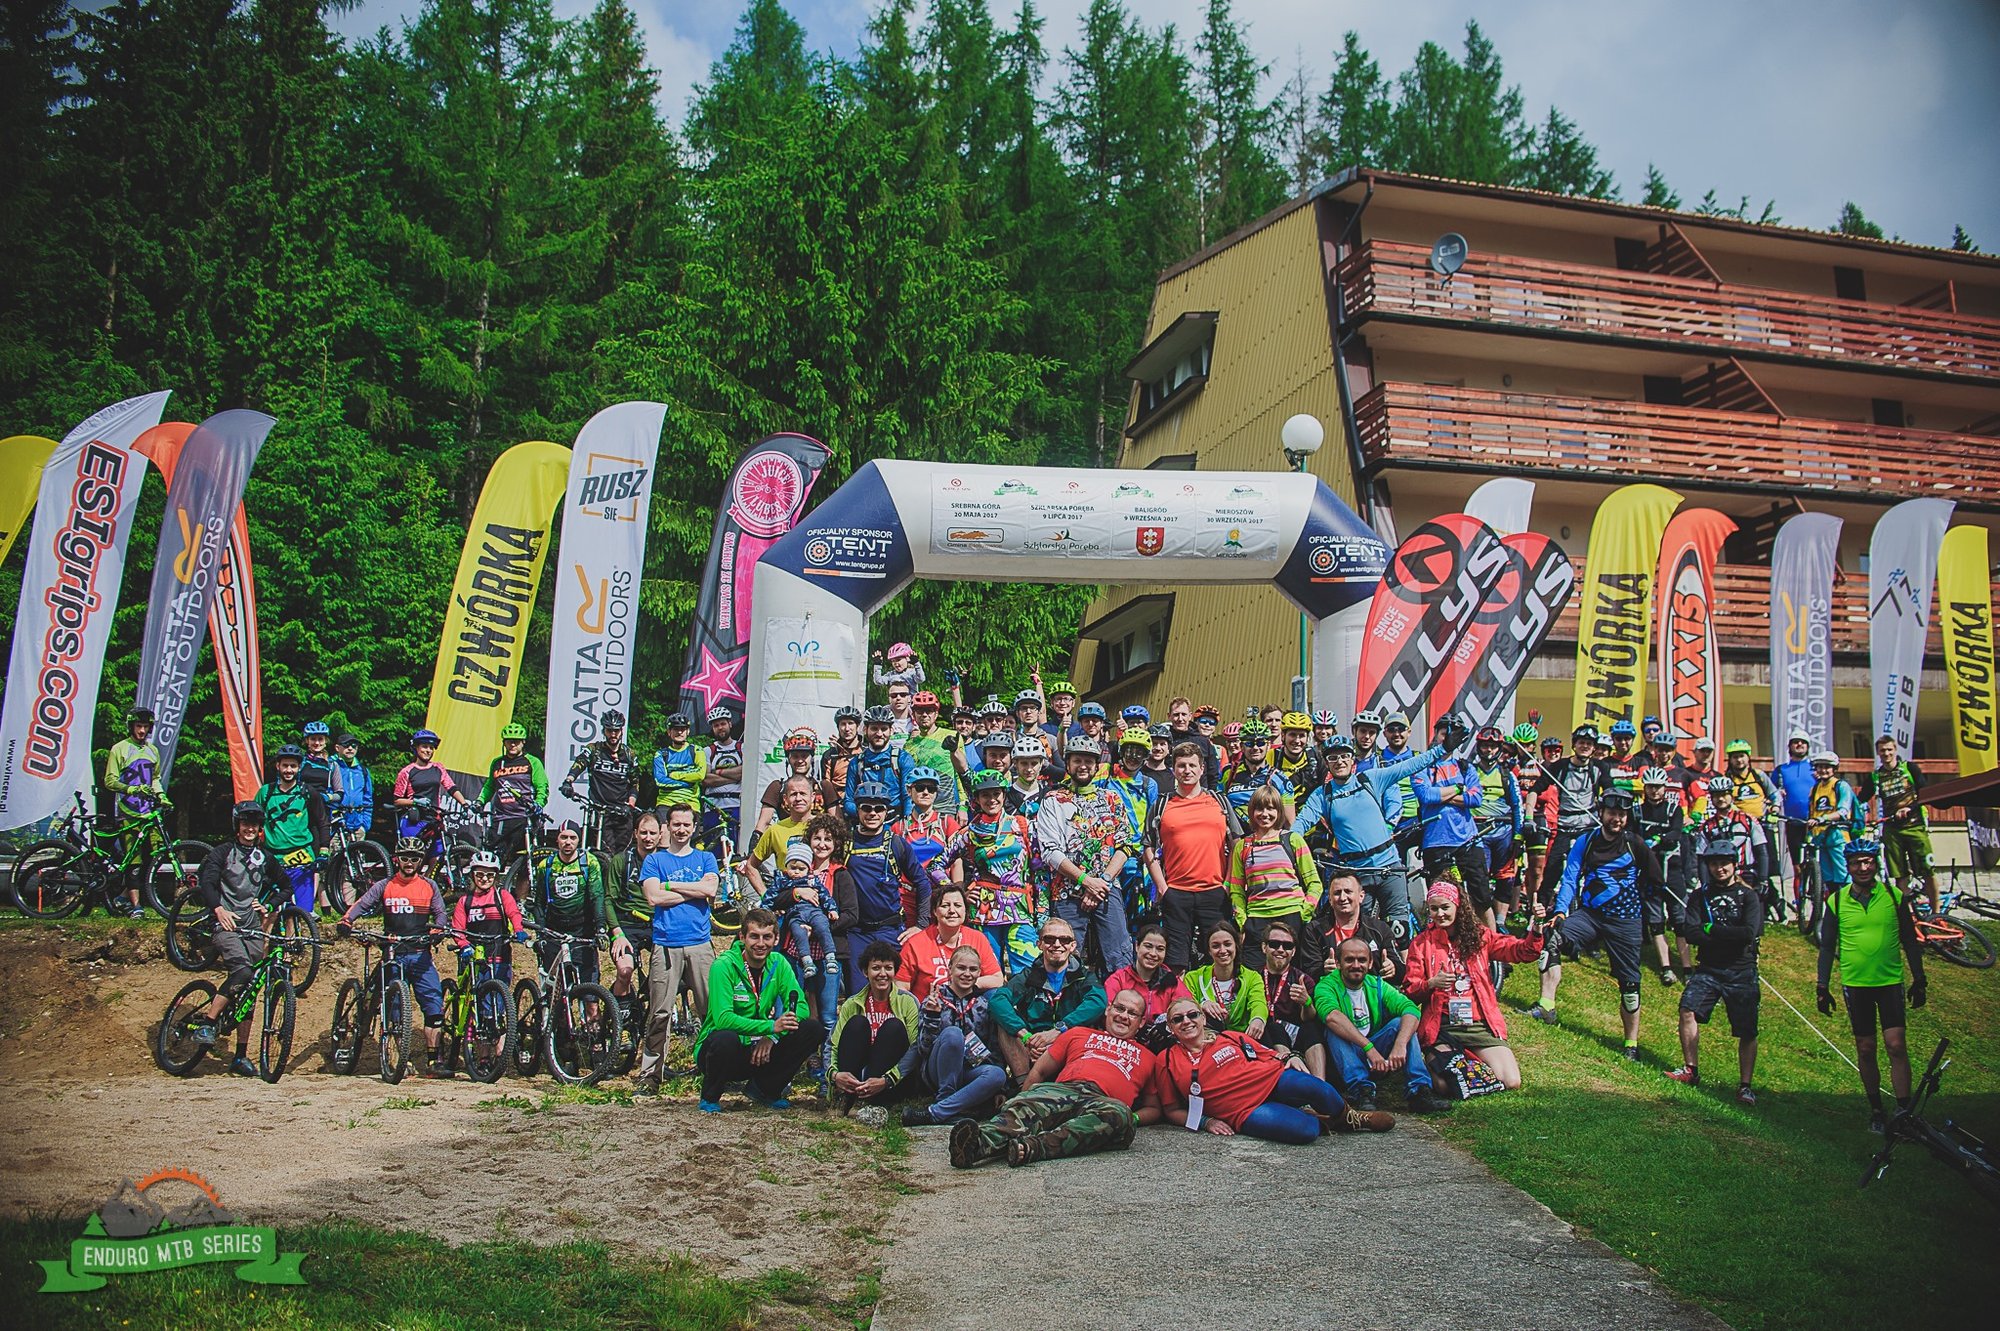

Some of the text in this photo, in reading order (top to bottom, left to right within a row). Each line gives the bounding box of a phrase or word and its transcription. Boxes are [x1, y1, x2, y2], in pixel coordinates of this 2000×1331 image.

[578, 469, 648, 507] RUSZ
[762, 464, 791, 484] JUICE
[603, 506, 618, 522] SIĘ
[750, 496, 782, 514] LUBES
[981, 502, 1001, 510] GÓRA
[1135, 506, 1168, 514] BALIGRÓD
[807, 528, 893, 539] OFICJALNY SPONSOR
[826, 536, 893, 552] TENT
[1309, 535, 1351, 544] OFICJALNY
[835, 550, 887, 559] GRUPA
[835, 560, 885, 570] www.tentgrupa.pl
[1330, 544, 1386, 558] TENT
[26, 441, 127, 778] ESIgrips.com
[448, 523, 545, 708] CZWÓRKA
[1373, 605, 1398, 639] SINCE
[159, 516, 225, 746] GREAT OUTDOORS
[603, 570, 631, 707] OUTDOORS
[1383, 613, 1410, 644] 1991
[1454, 633, 1480, 665] 1991
[1580, 573, 1648, 728] ZWÓRKA
[1808, 597, 1827, 717] OUTDOORS
[1672, 590, 1708, 745] AXXIS
[1953, 601, 1993, 752] CZWÓRKA
[1883, 674, 1898, 733] RSKICH
